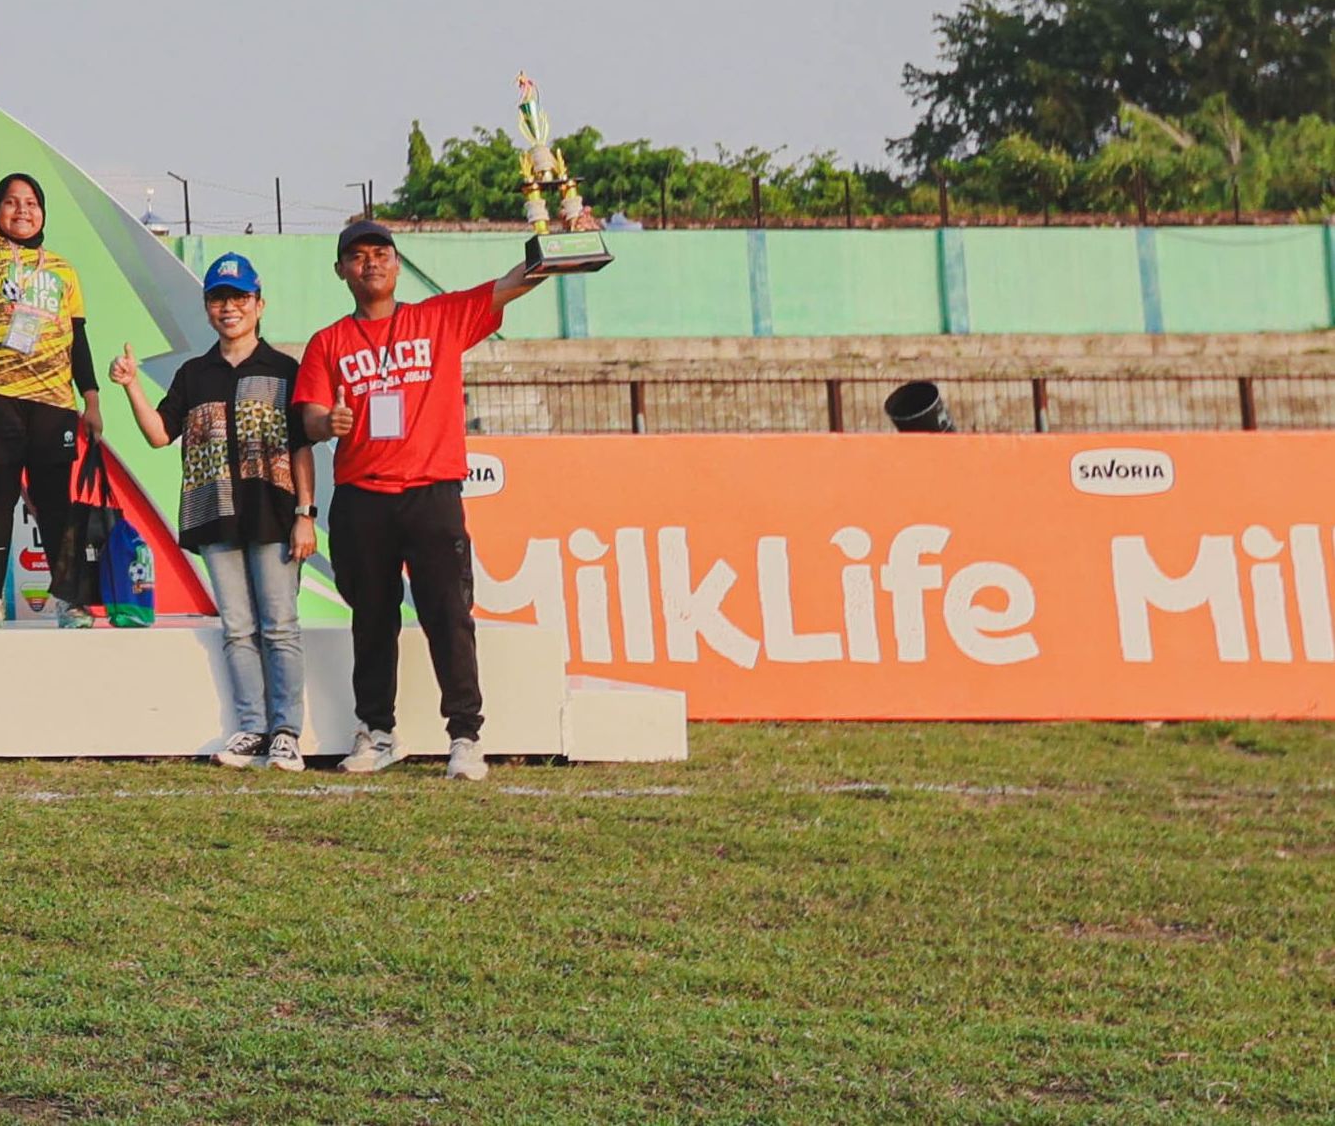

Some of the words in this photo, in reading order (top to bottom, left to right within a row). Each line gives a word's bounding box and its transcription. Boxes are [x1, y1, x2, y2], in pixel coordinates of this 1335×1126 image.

[339, 338, 432, 384] COACH
[1078, 457, 1166, 483] SAVORIA
[473, 524, 1040, 669] MilkLife
[1111, 523, 1335, 663] Mil
